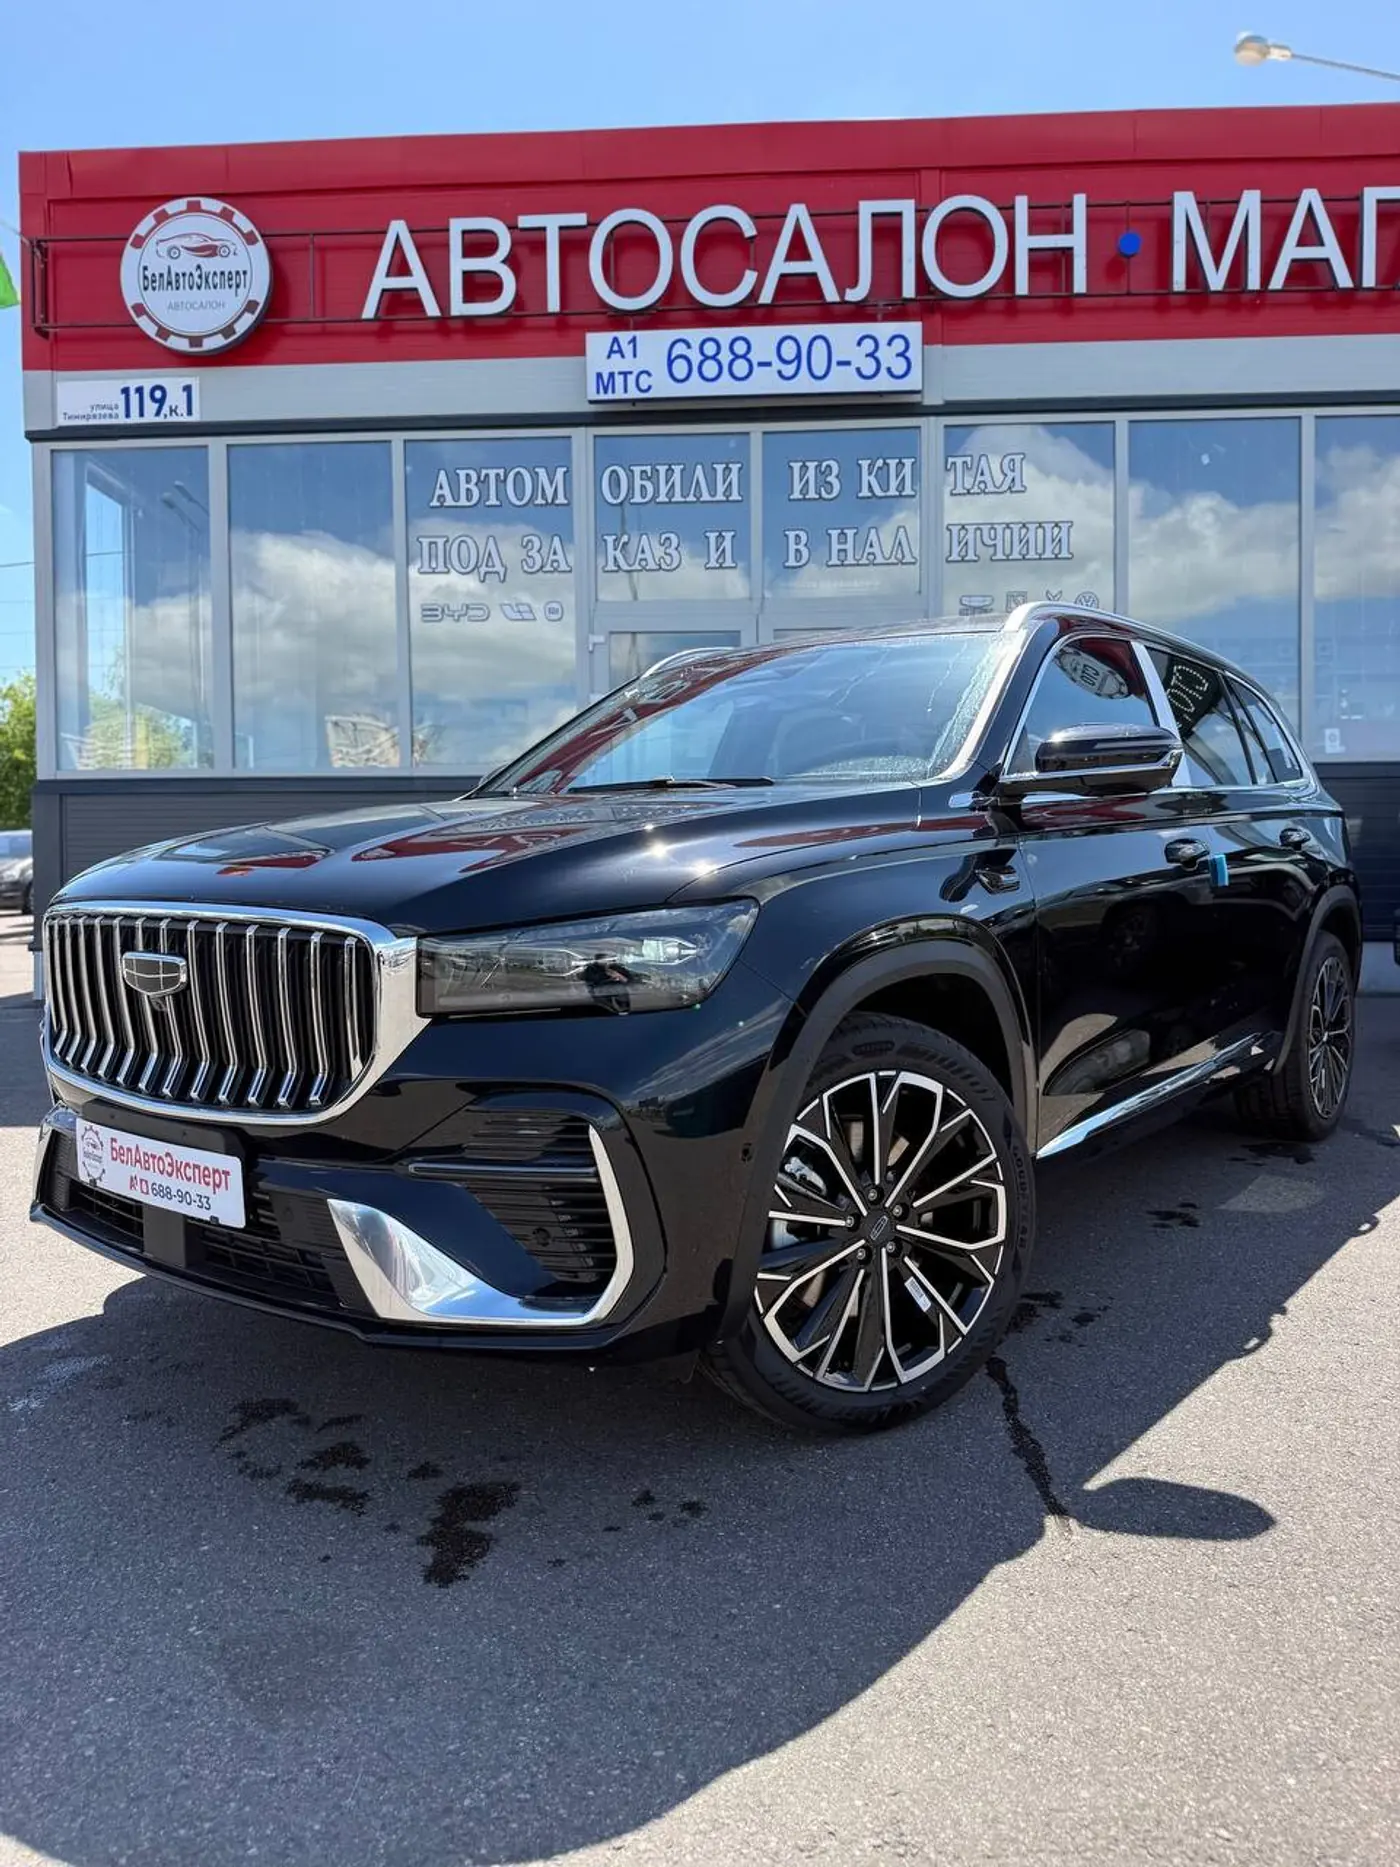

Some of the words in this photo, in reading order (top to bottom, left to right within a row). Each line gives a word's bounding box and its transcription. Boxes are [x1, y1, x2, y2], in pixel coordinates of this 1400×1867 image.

[361, 193, 1087, 320] АВТОСАЛОН
[142, 264, 248, 297] БелАвтоЭксперт
[167, 300, 226, 312] АВТОСАЛОН
[666, 334, 912, 384] 688-90-33
[595, 370, 653, 395] МТС
[63, 411, 119, 422] Тимирязева
[90, 403, 119, 413] улица
[788, 459, 841, 500] ИЗ
[417, 535, 506, 583] ПОД
[704, 529, 737, 570] И
[783, 528, 811, 569] В
[421, 602, 490, 622] BYD
[110, 1136, 231, 1194] БелАвтоЭксперт
[151, 1182, 212, 1211] 688-90-33
